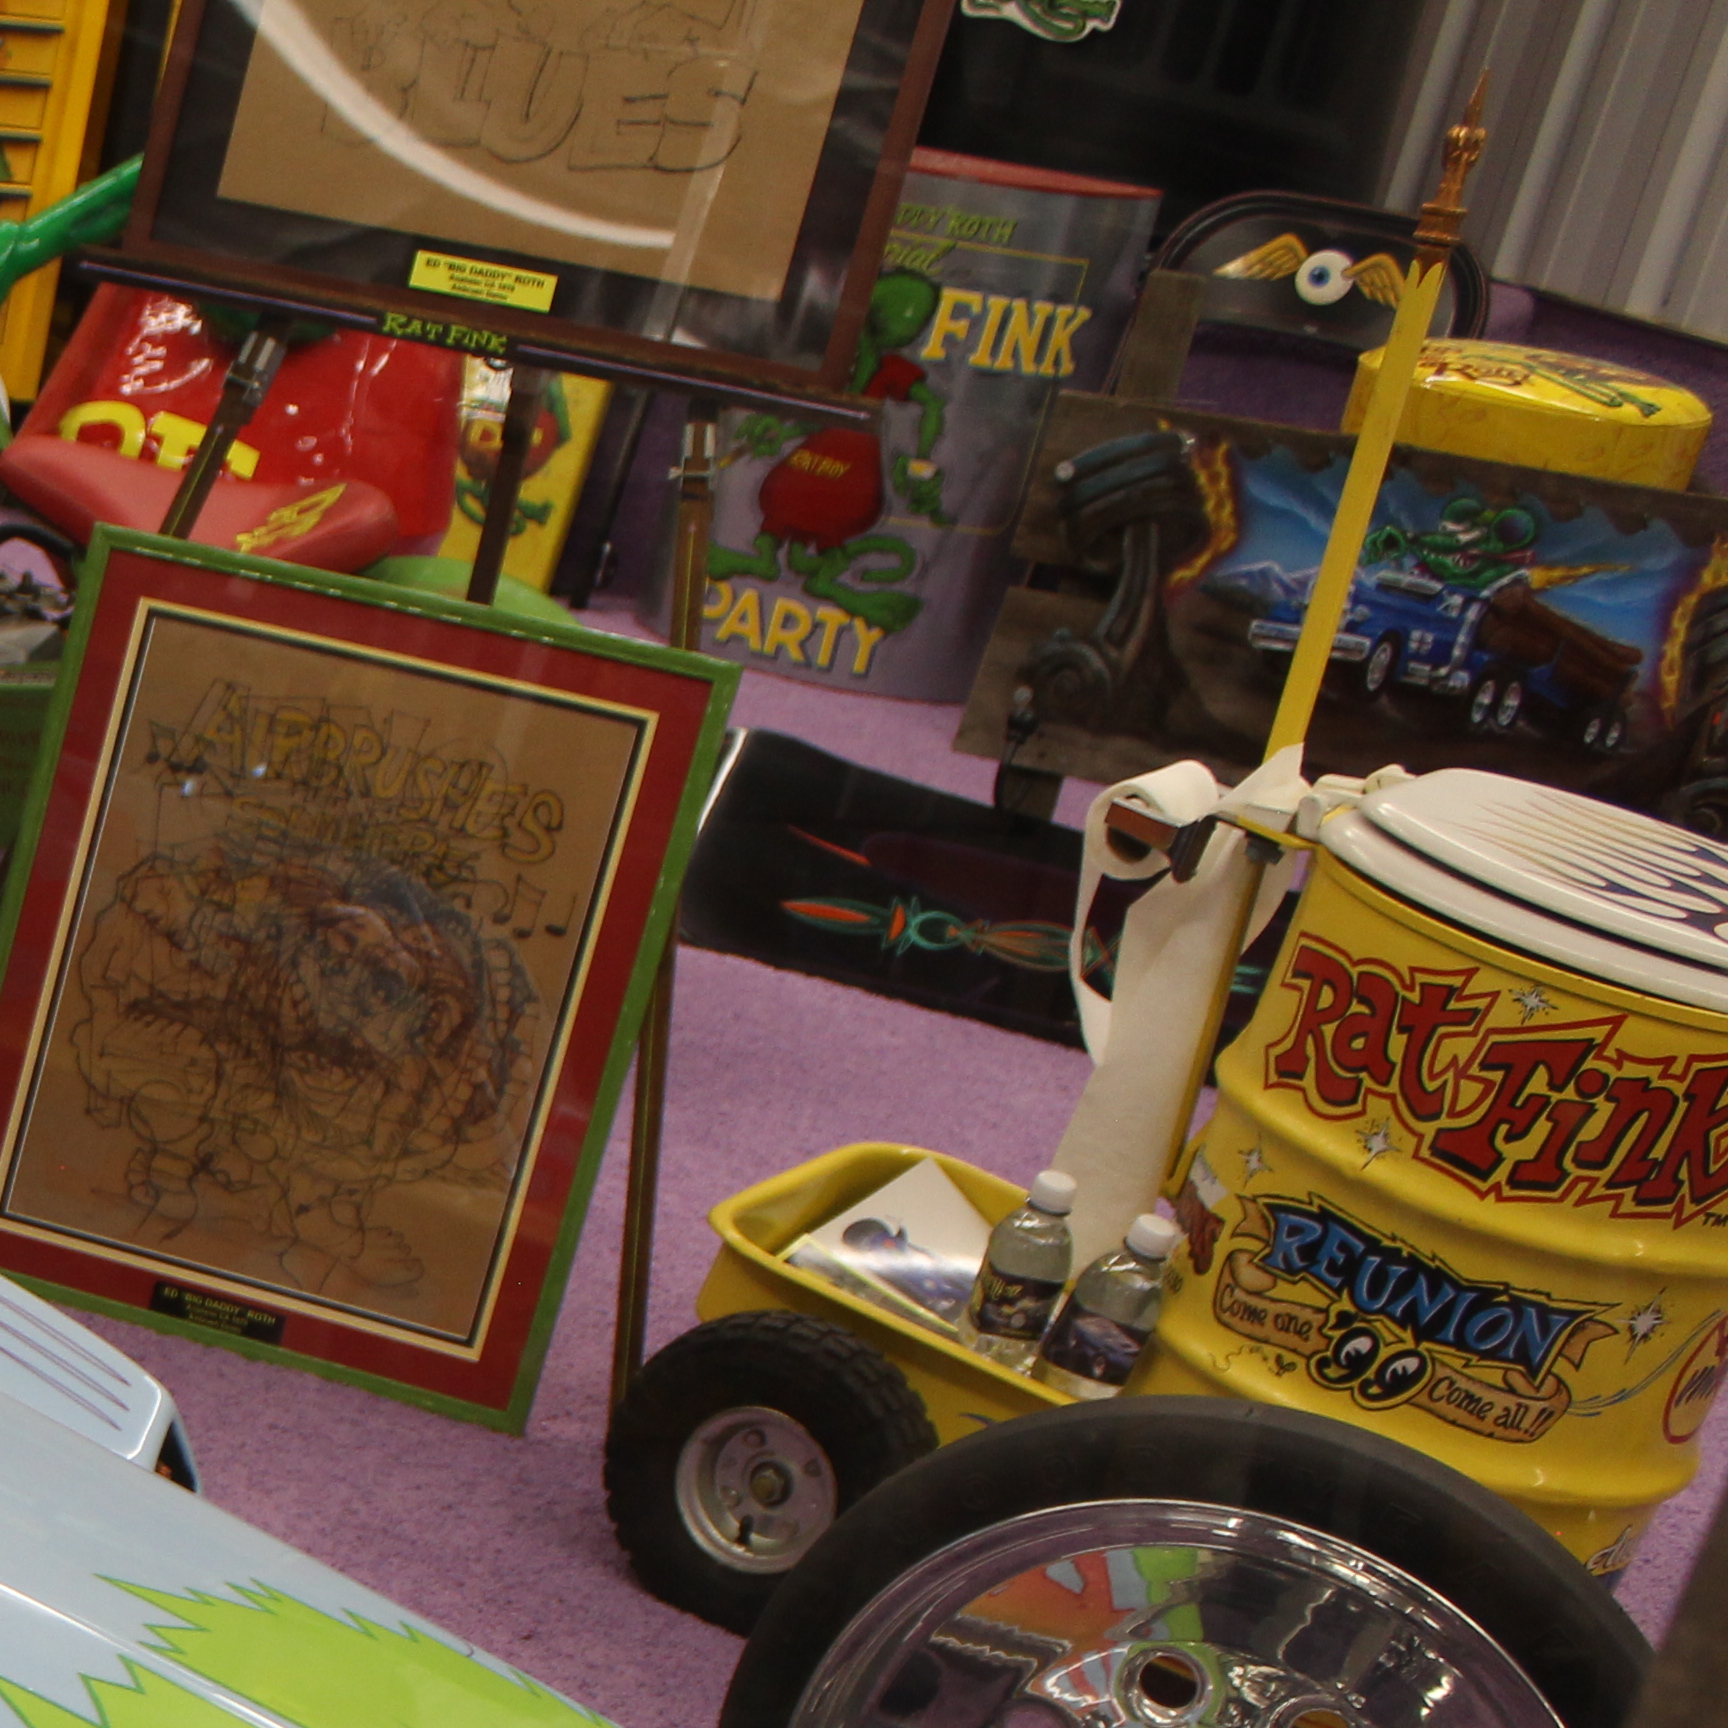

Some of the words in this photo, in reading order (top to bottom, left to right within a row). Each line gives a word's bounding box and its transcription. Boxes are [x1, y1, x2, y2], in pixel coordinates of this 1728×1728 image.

[382, 311, 443, 341] RAT
[445, 323, 508, 355] FINK
[921, 286, 1092, 378] FINK
[702, 576, 887, 676] PARTY
[1273, 942, 1482, 1123] Rat
[1428, 1036, 1728, 1208] Fink
[1218, 1282, 1268, 1327] Come
[1261, 1210, 1580, 1368] REUNION
[1426, 1374, 1497, 1421] Come
